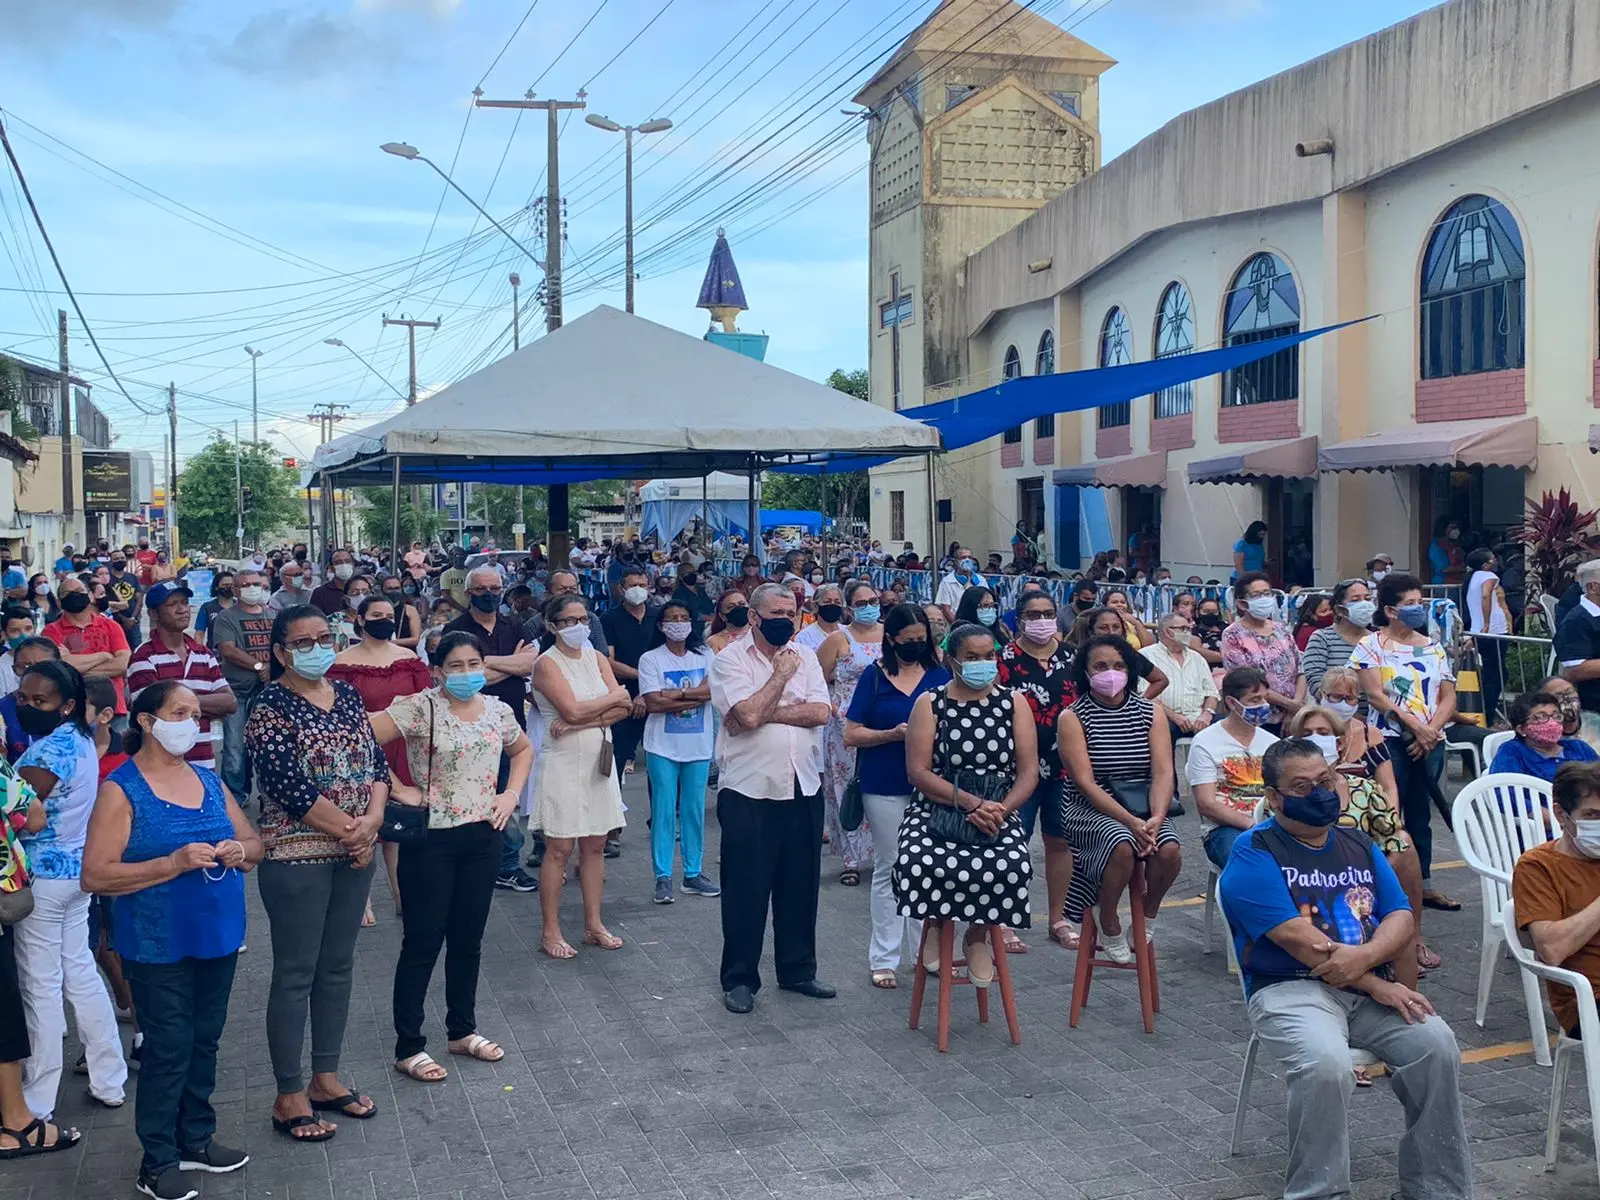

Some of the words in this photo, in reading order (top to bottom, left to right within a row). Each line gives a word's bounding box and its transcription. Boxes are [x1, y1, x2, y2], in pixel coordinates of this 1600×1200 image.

[450, 577, 464, 585] BO
[243, 620, 273, 630] NEVE
[249, 650, 270, 662] ENO
[1281, 866, 1374, 888] Padroeira
